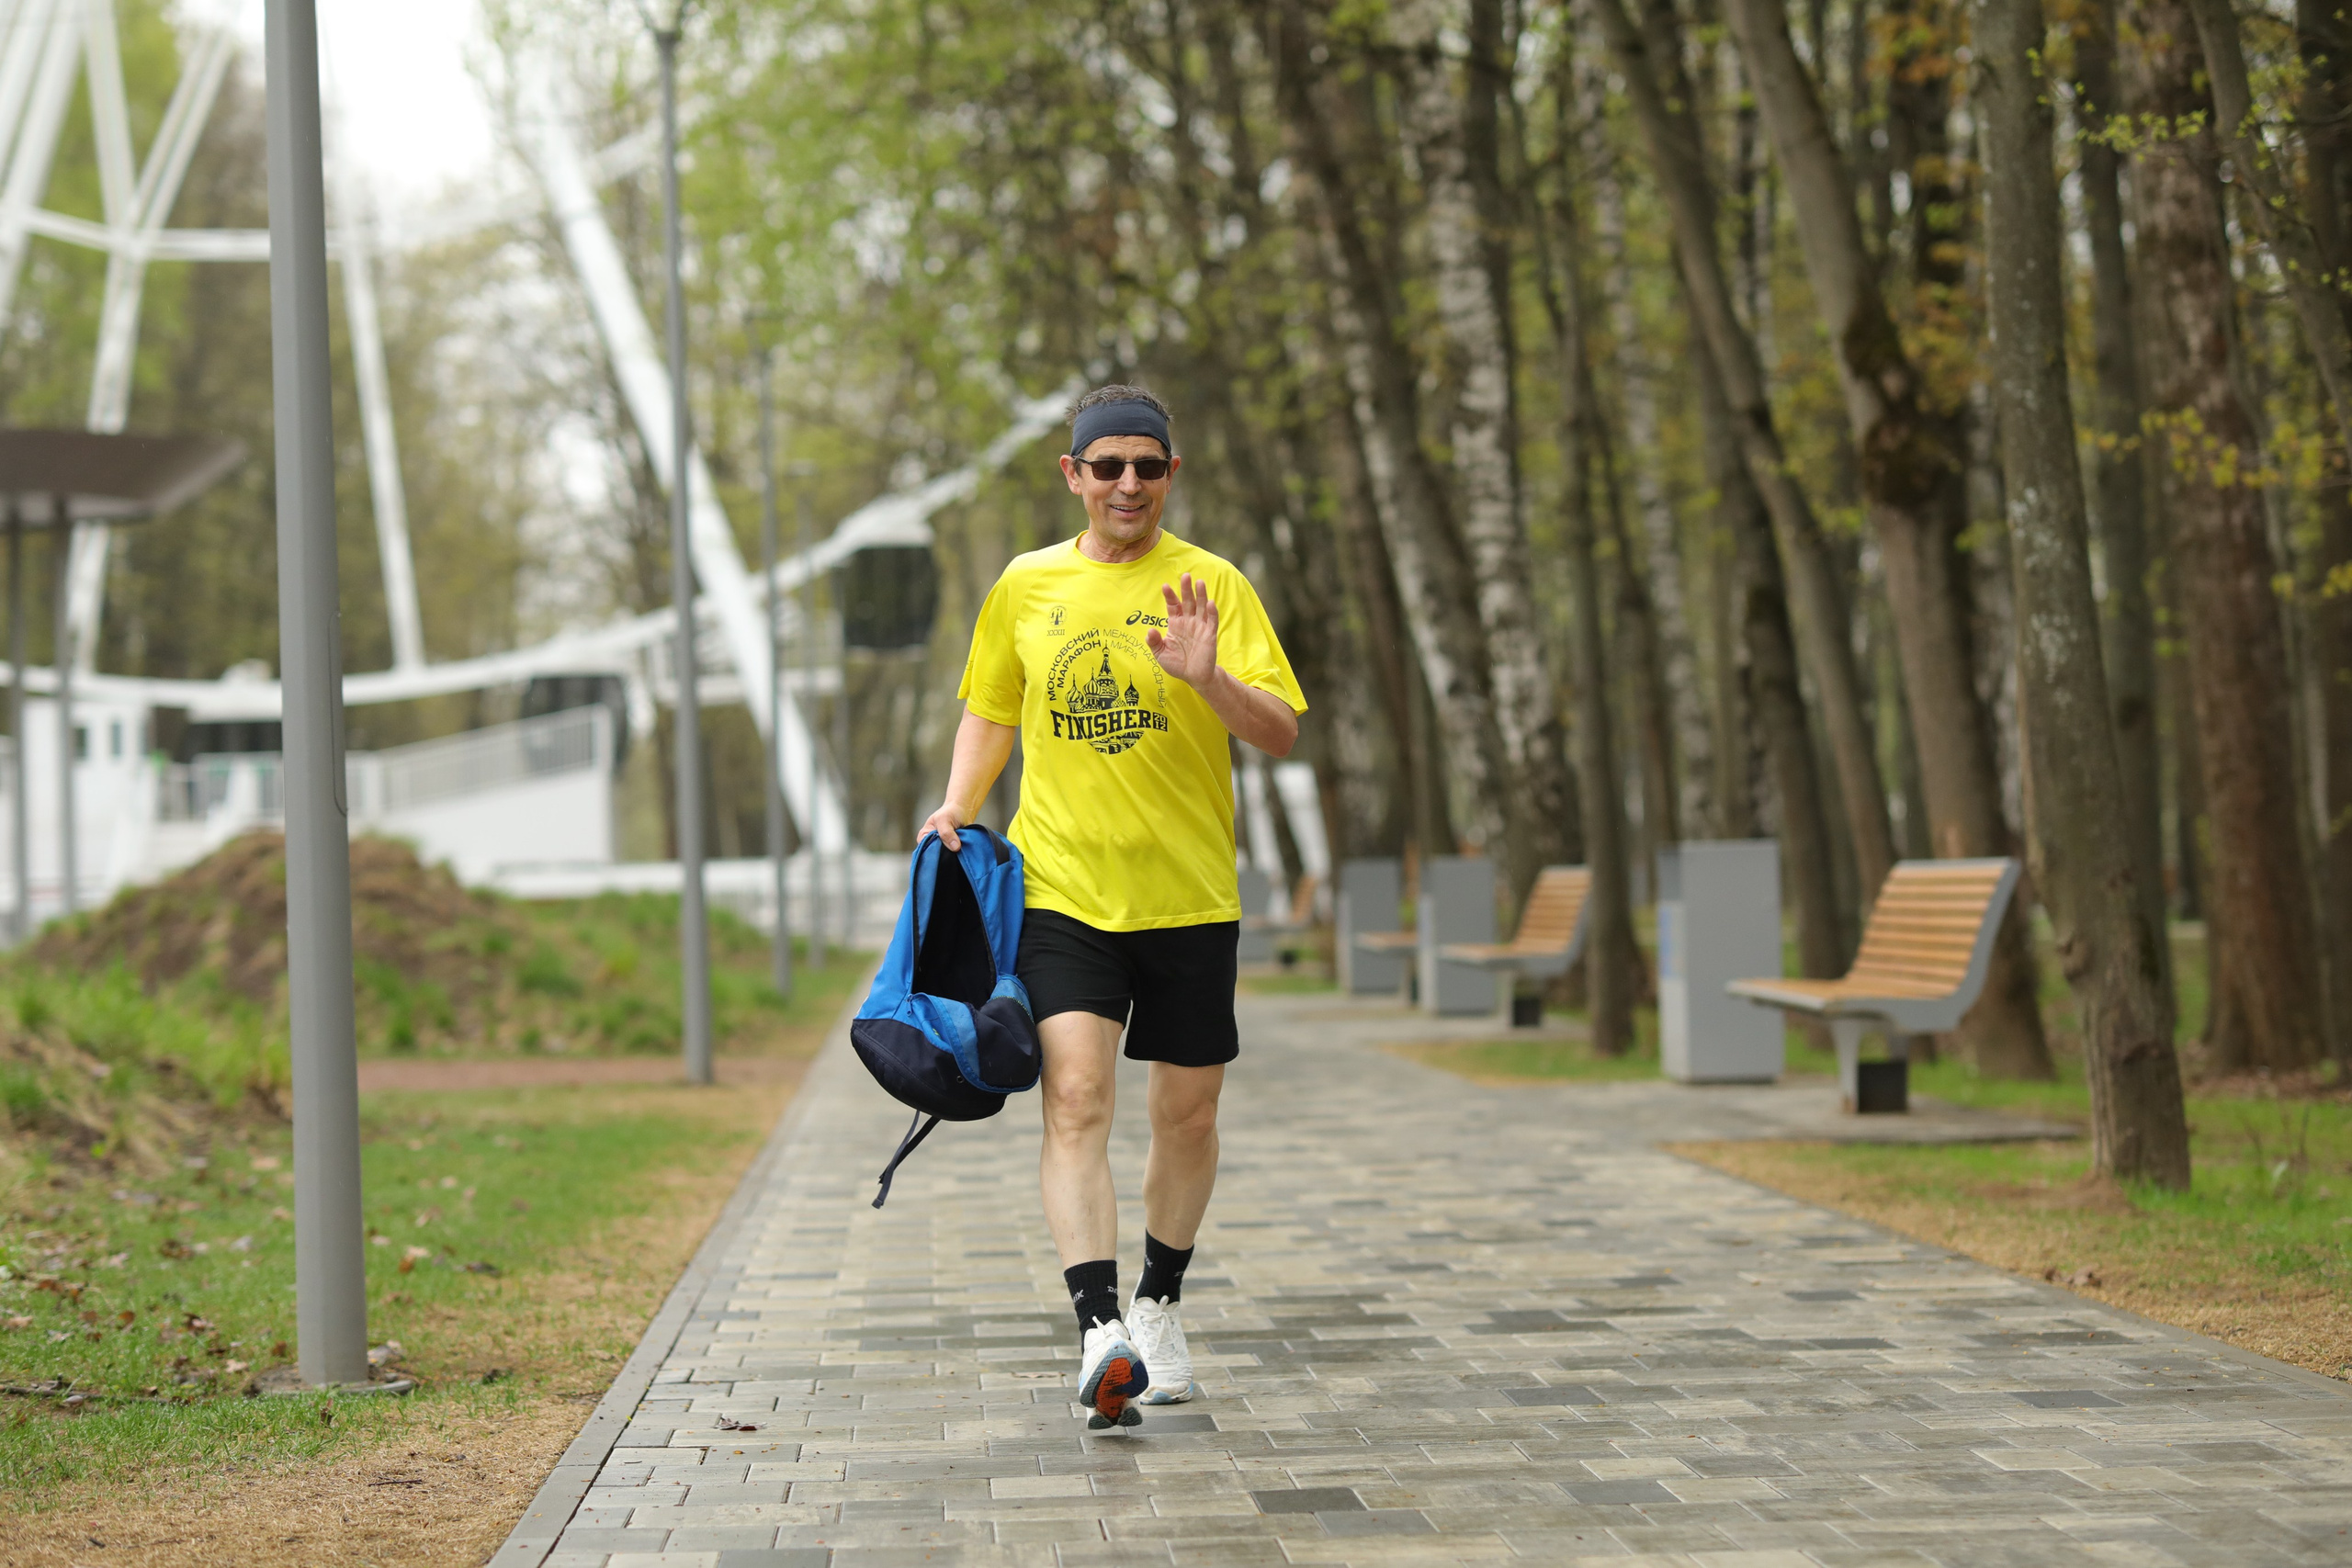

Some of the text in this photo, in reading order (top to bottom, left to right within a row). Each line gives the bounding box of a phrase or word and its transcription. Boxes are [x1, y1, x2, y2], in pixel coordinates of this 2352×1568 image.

[1047, 627, 1167, 708] МОСКОВСКИЙ МЕЖДУНАРОДНЫЙ
[1057, 639, 1138, 688] МАРАФОН МИРА
[1050, 709, 1152, 740] FINISHER
